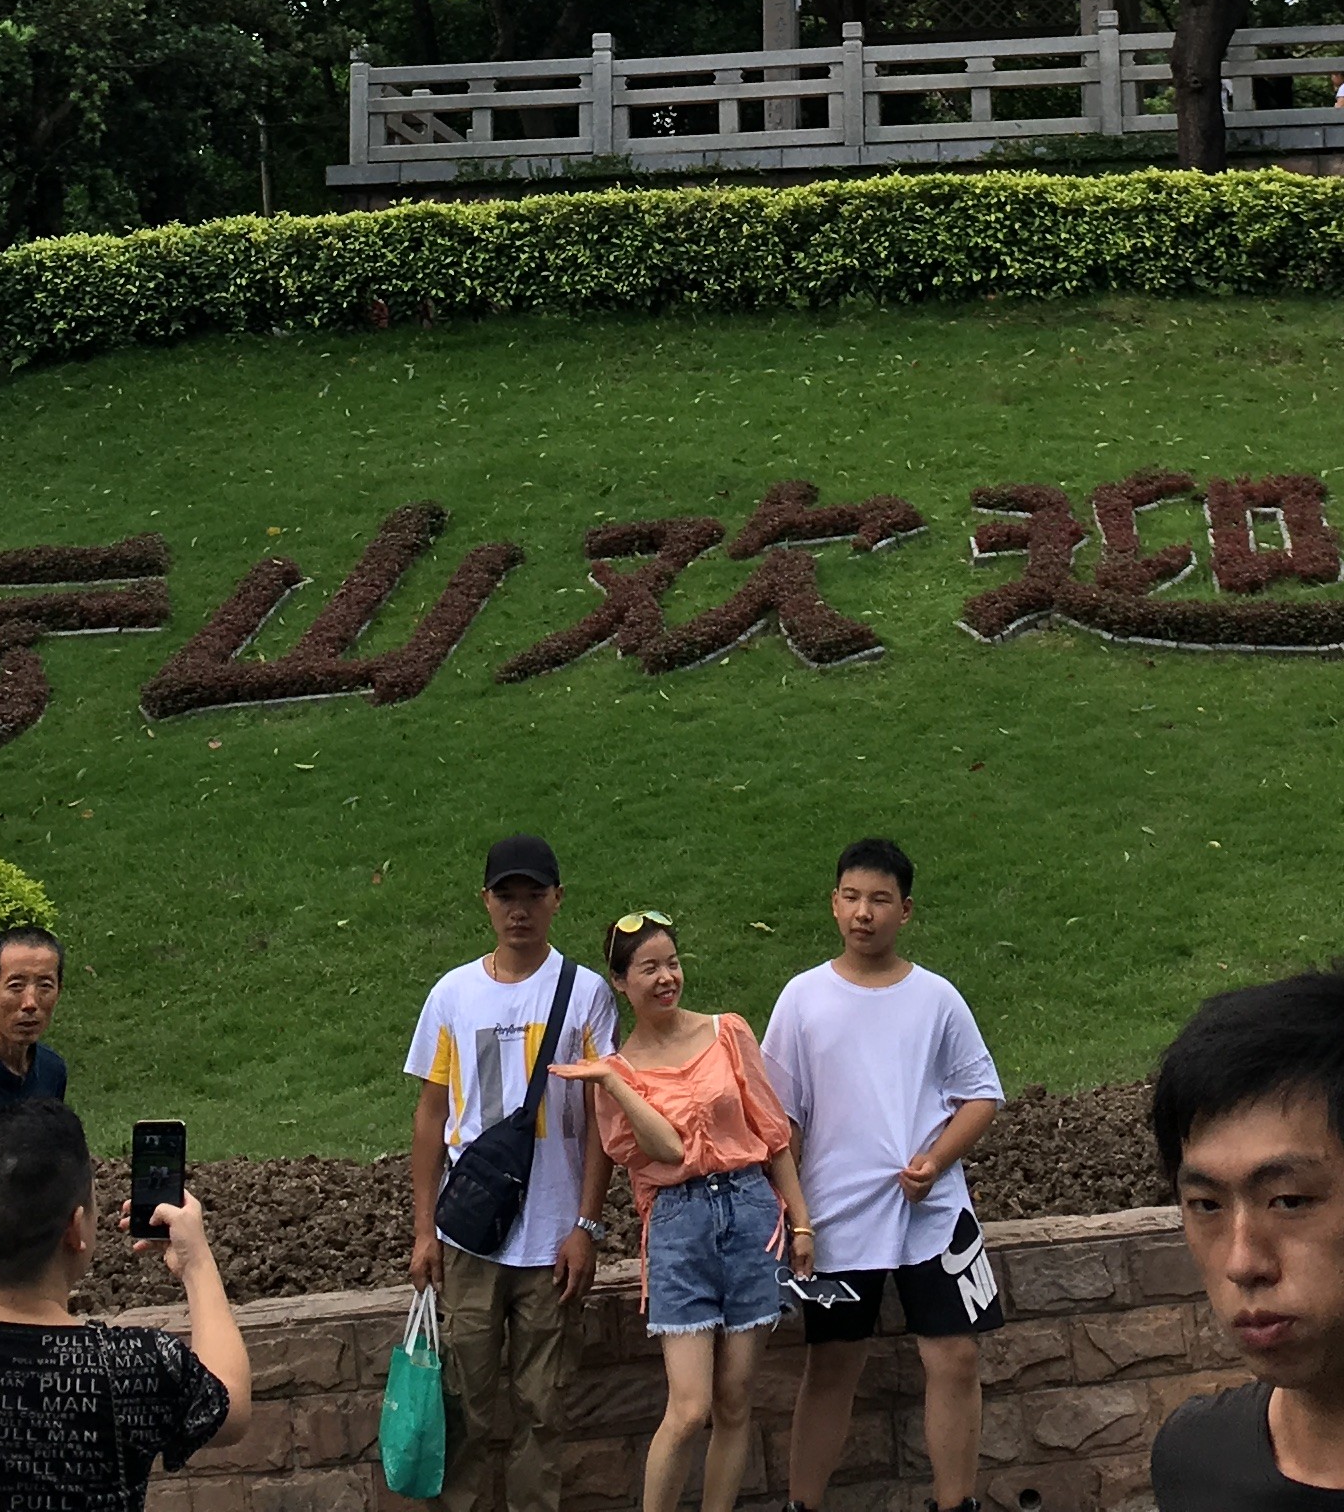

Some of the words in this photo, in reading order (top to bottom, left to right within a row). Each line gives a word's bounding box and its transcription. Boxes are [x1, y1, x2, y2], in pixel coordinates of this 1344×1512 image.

[41, 1335, 94, 1347] PULL
[59, 1353, 109, 1367] PULL
[114, 1352, 157, 1368] MAN
[40, 1377, 102, 1394] PULL
[113, 1377, 160, 1394] MAN
[42, 1396, 97, 1413] MAN
[115, 1414, 156, 1426] PULL
[48, 1430, 98, 1444] MAN
[6, 1460, 56, 1475] PULL
[64, 1461, 114, 1477] MAN
[10, 1494, 73, 1511] PULL
